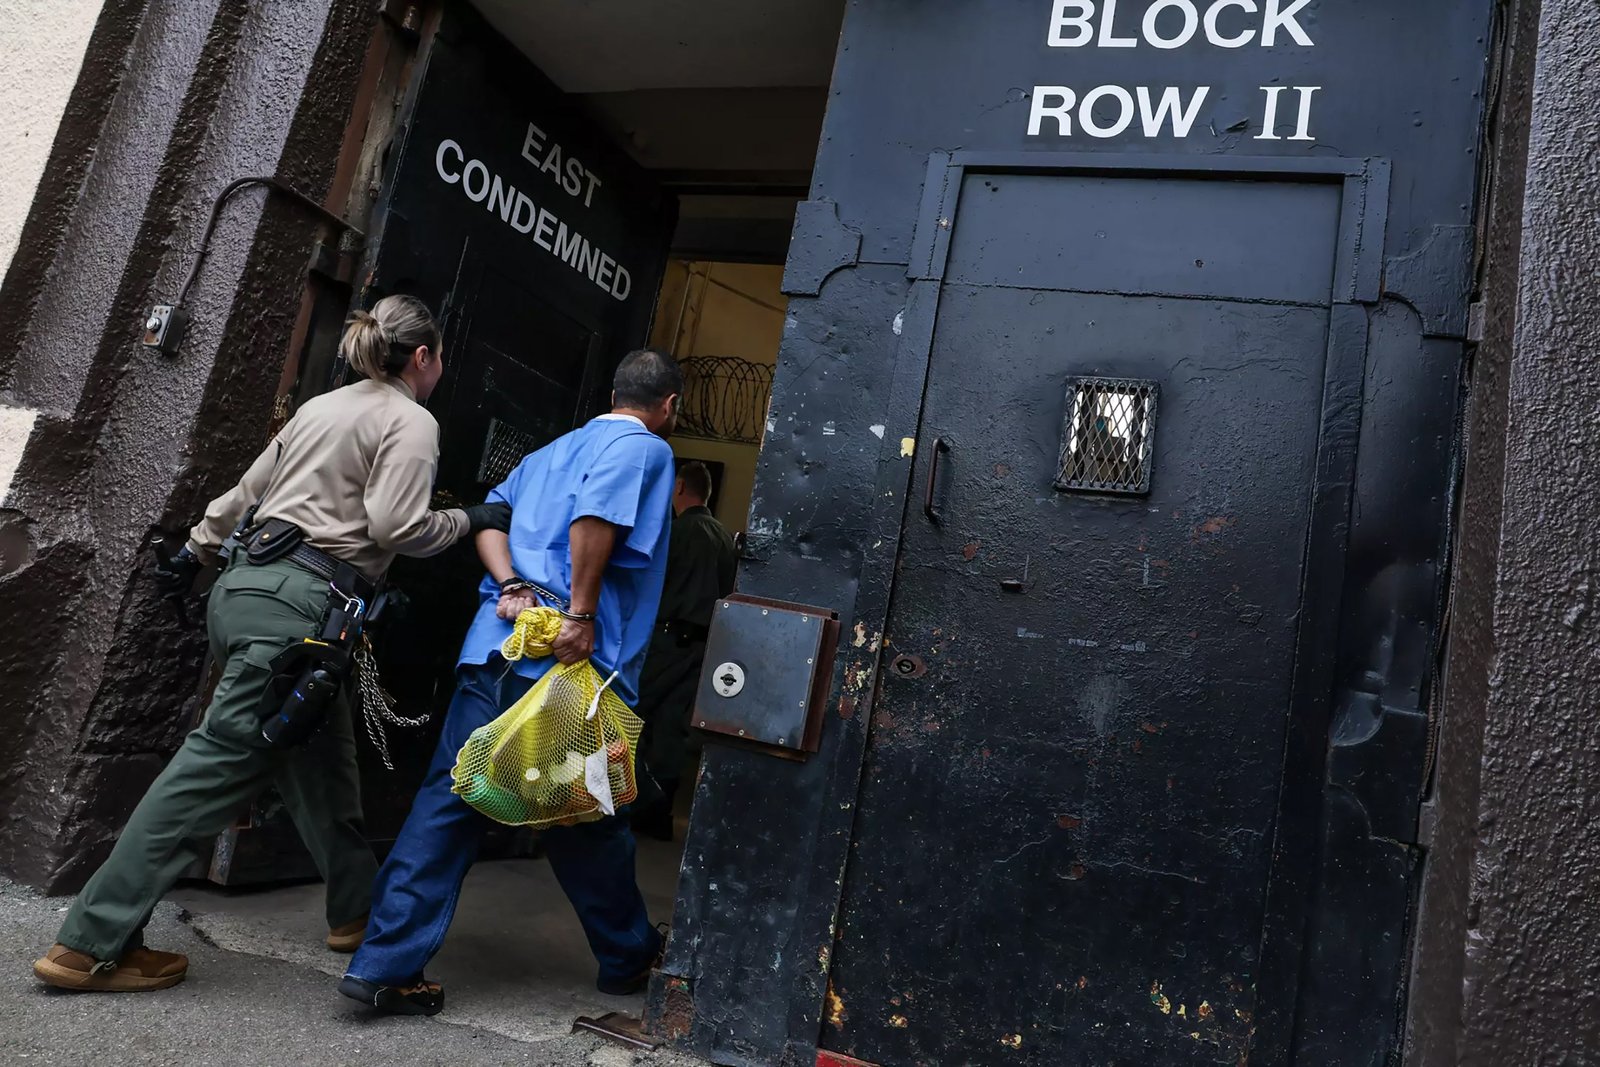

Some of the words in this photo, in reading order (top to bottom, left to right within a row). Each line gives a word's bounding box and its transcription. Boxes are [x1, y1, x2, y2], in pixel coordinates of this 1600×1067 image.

[1047, 0, 1315, 50] BLOCK
[1027, 85, 1210, 138] ROW
[1253, 86, 1322, 141] II
[521, 122, 602, 208] EAST
[436, 139, 631, 301] CONDEMNED
